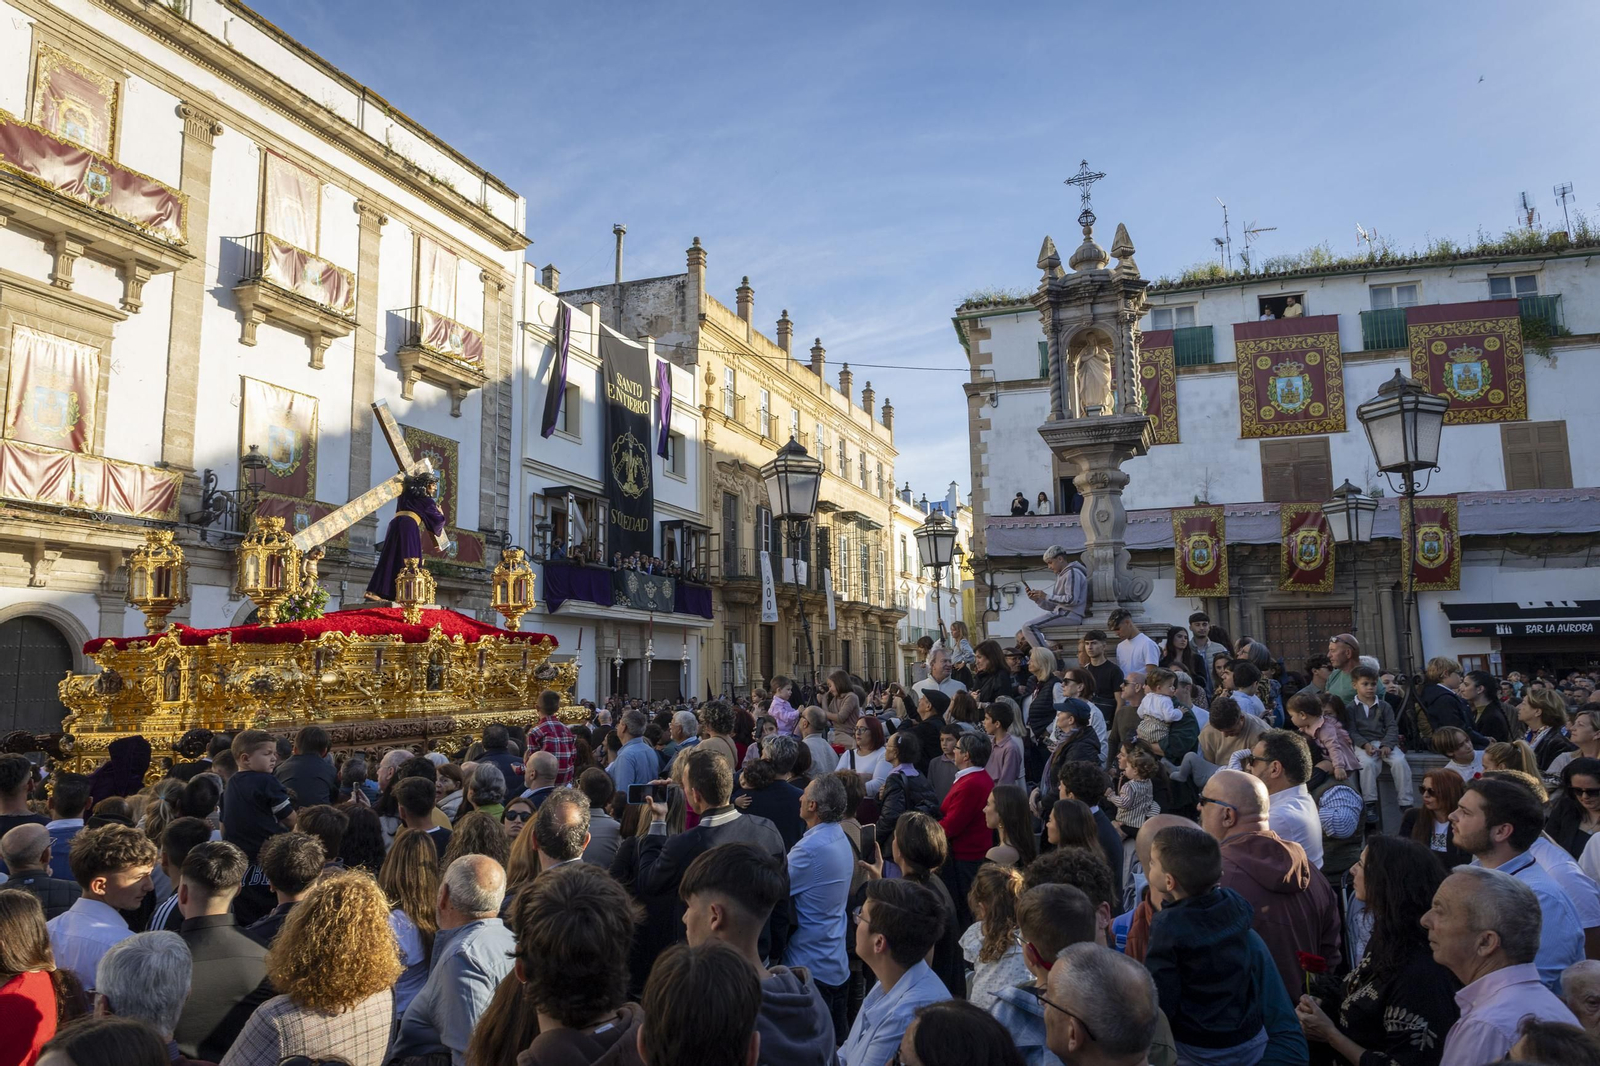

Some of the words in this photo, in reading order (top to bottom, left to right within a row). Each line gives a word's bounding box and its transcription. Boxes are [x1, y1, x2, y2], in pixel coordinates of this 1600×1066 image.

[607, 382, 649, 414] ENTIERRO
[617, 372, 642, 398] SANTO
[1525, 624, 1544, 634] BAR
[1545, 624, 1556, 633] LA
[1556, 623, 1594, 633] AURORA
